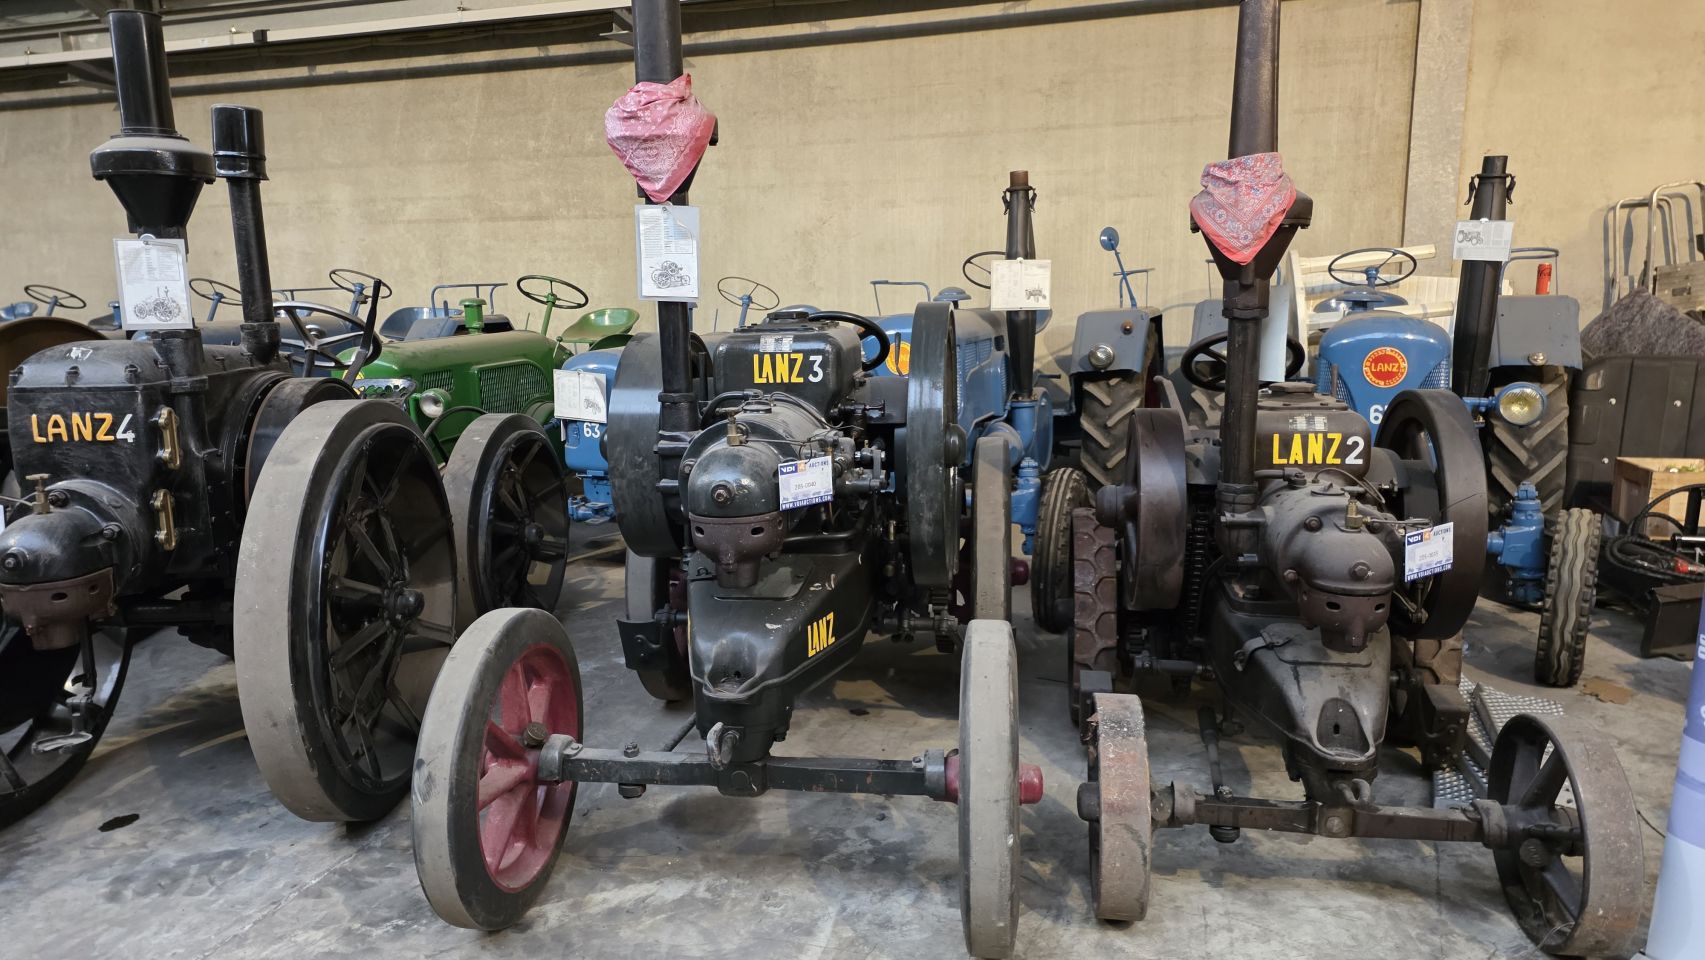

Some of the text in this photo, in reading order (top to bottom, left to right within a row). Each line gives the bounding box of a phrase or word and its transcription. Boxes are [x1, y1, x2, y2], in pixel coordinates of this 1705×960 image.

[753, 353, 823, 383] LANZ 3
[1371, 363, 1400, 373] LANZ
[1369, 404, 1388, 425] 6
[31, 412, 135, 443] LANZ 4
[583, 422, 600, 439] 63
[1272, 433, 1365, 465] LANZ 2
[781, 465, 796, 473] VDI
[1407, 535, 1421, 543] VDI
[807, 611, 836, 658] LANZ
